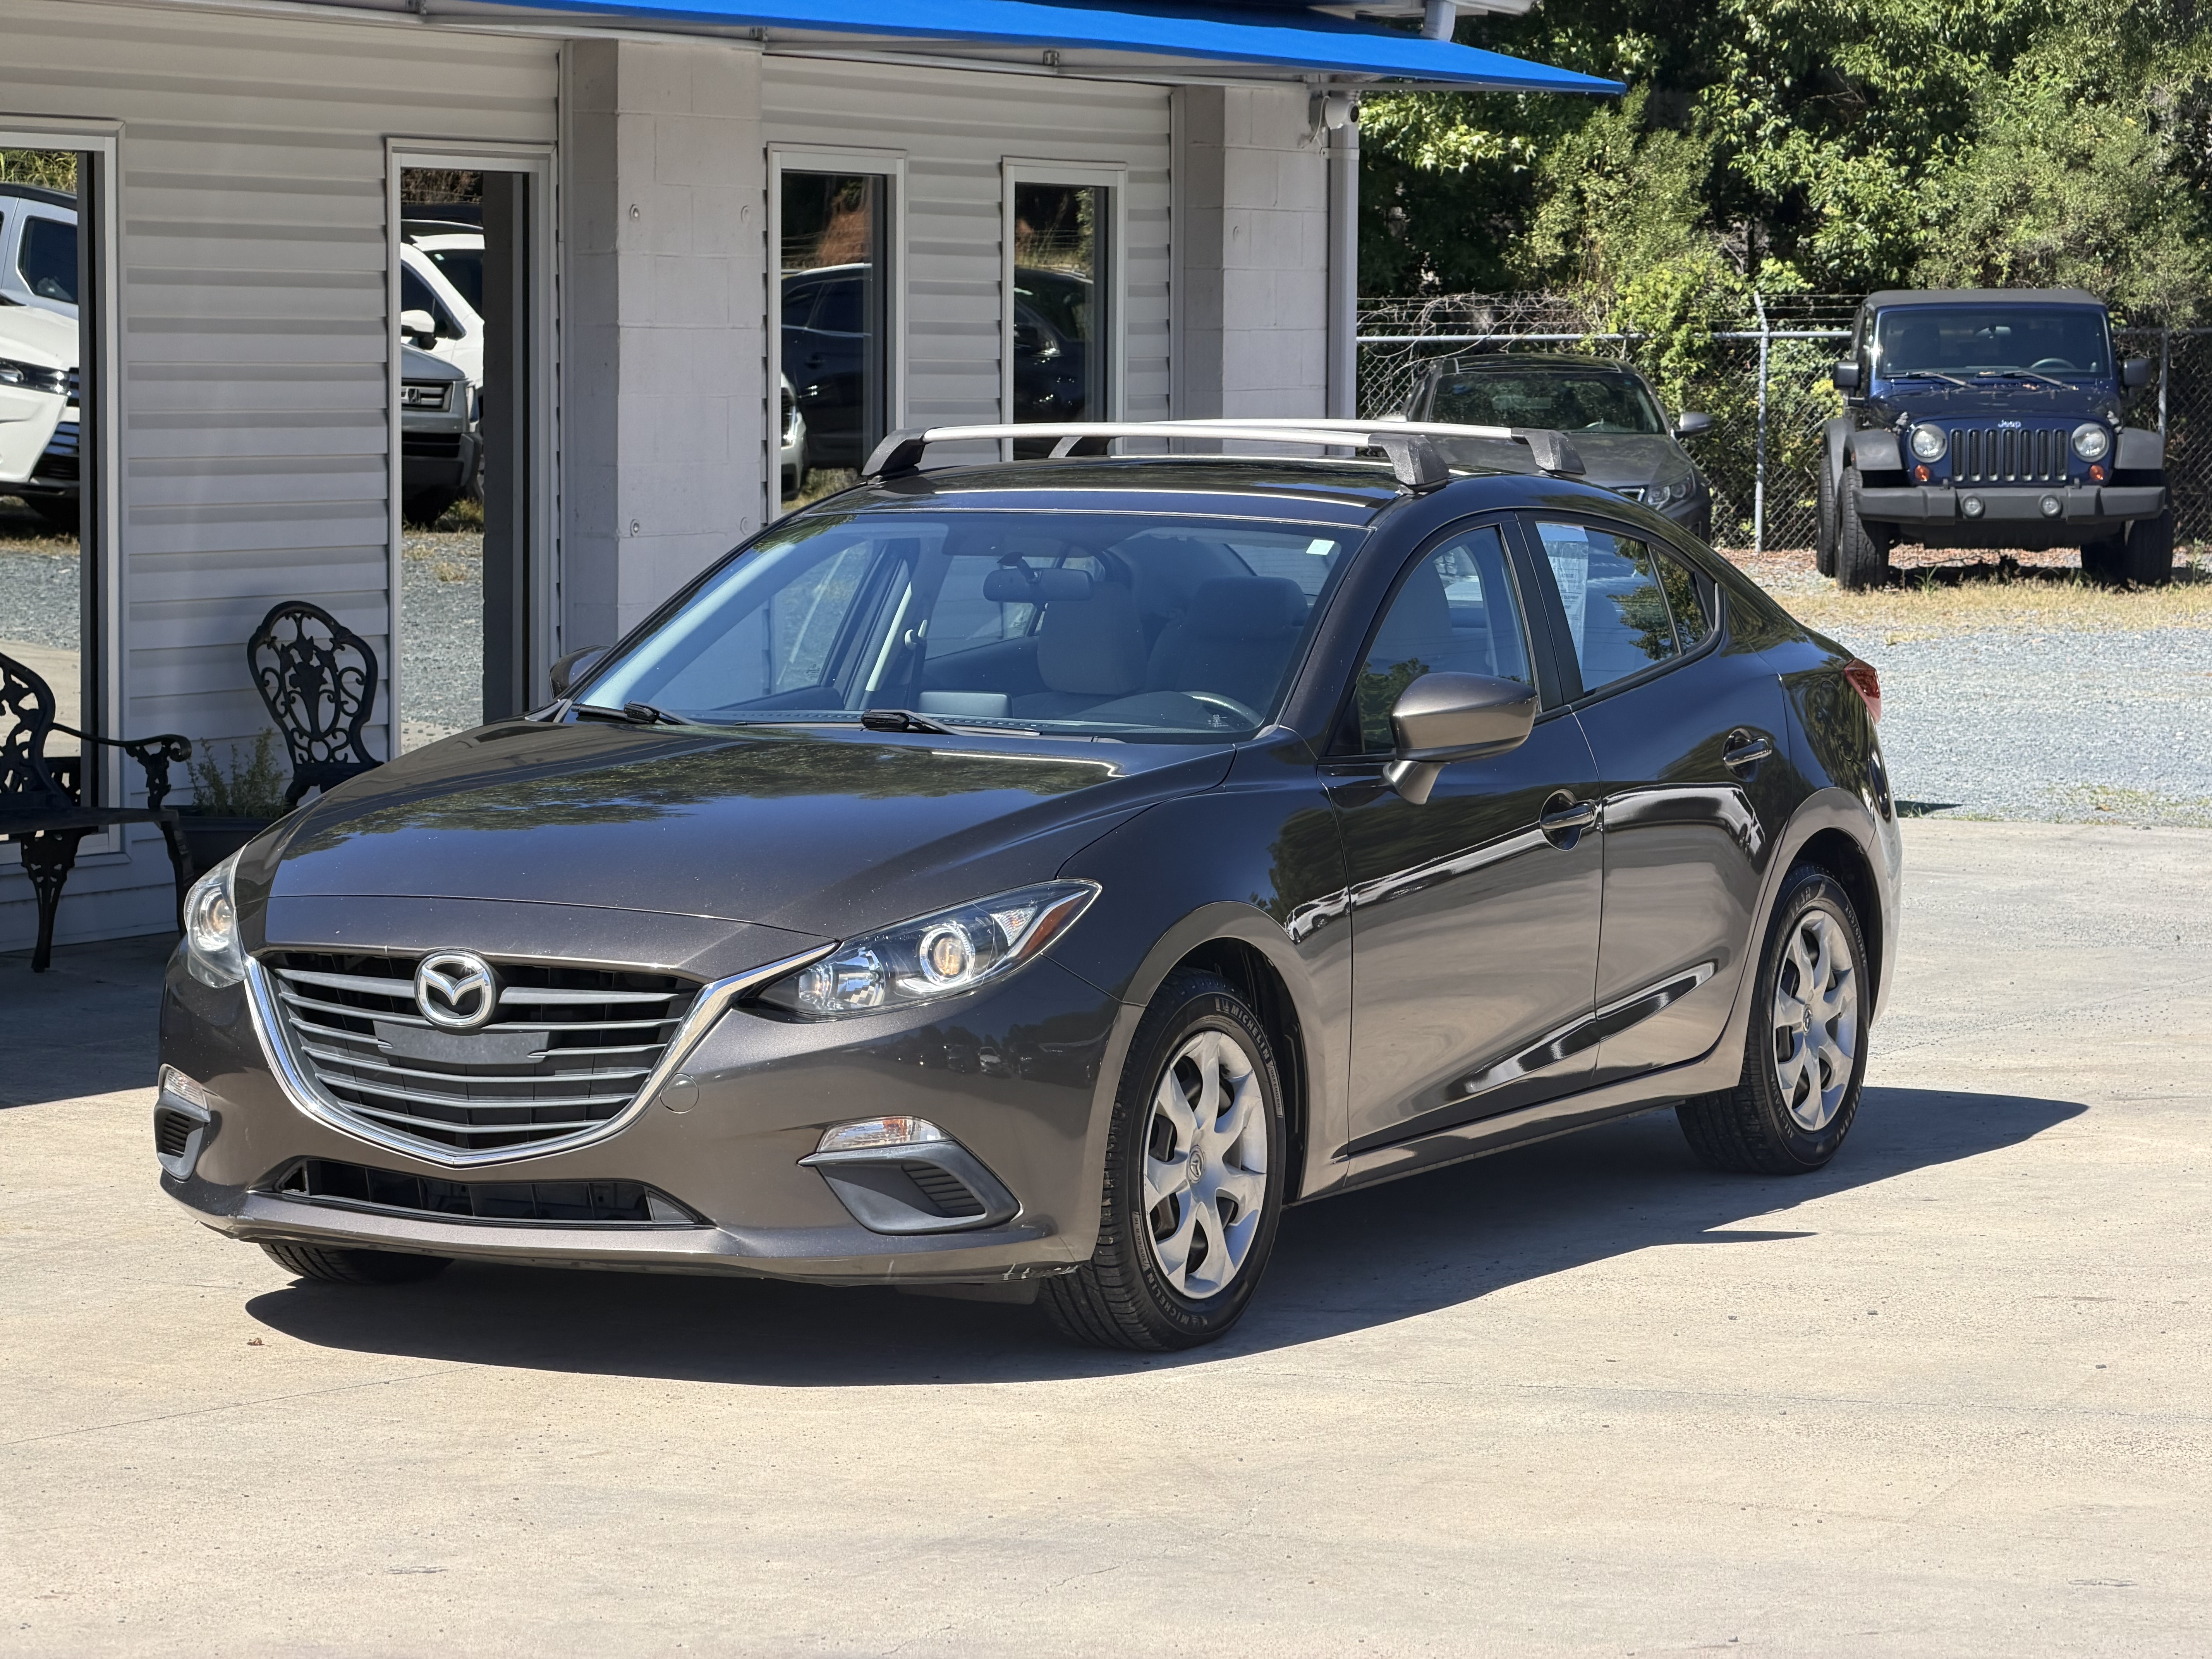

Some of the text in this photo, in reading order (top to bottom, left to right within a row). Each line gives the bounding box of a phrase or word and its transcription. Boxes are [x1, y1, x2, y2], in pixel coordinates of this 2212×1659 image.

[1997, 419, 2021, 429] Jeep
[1231, 1005, 1281, 1108] MICHELIN DEFENDER
[1147, 1274, 1189, 1324] MICHELIN
